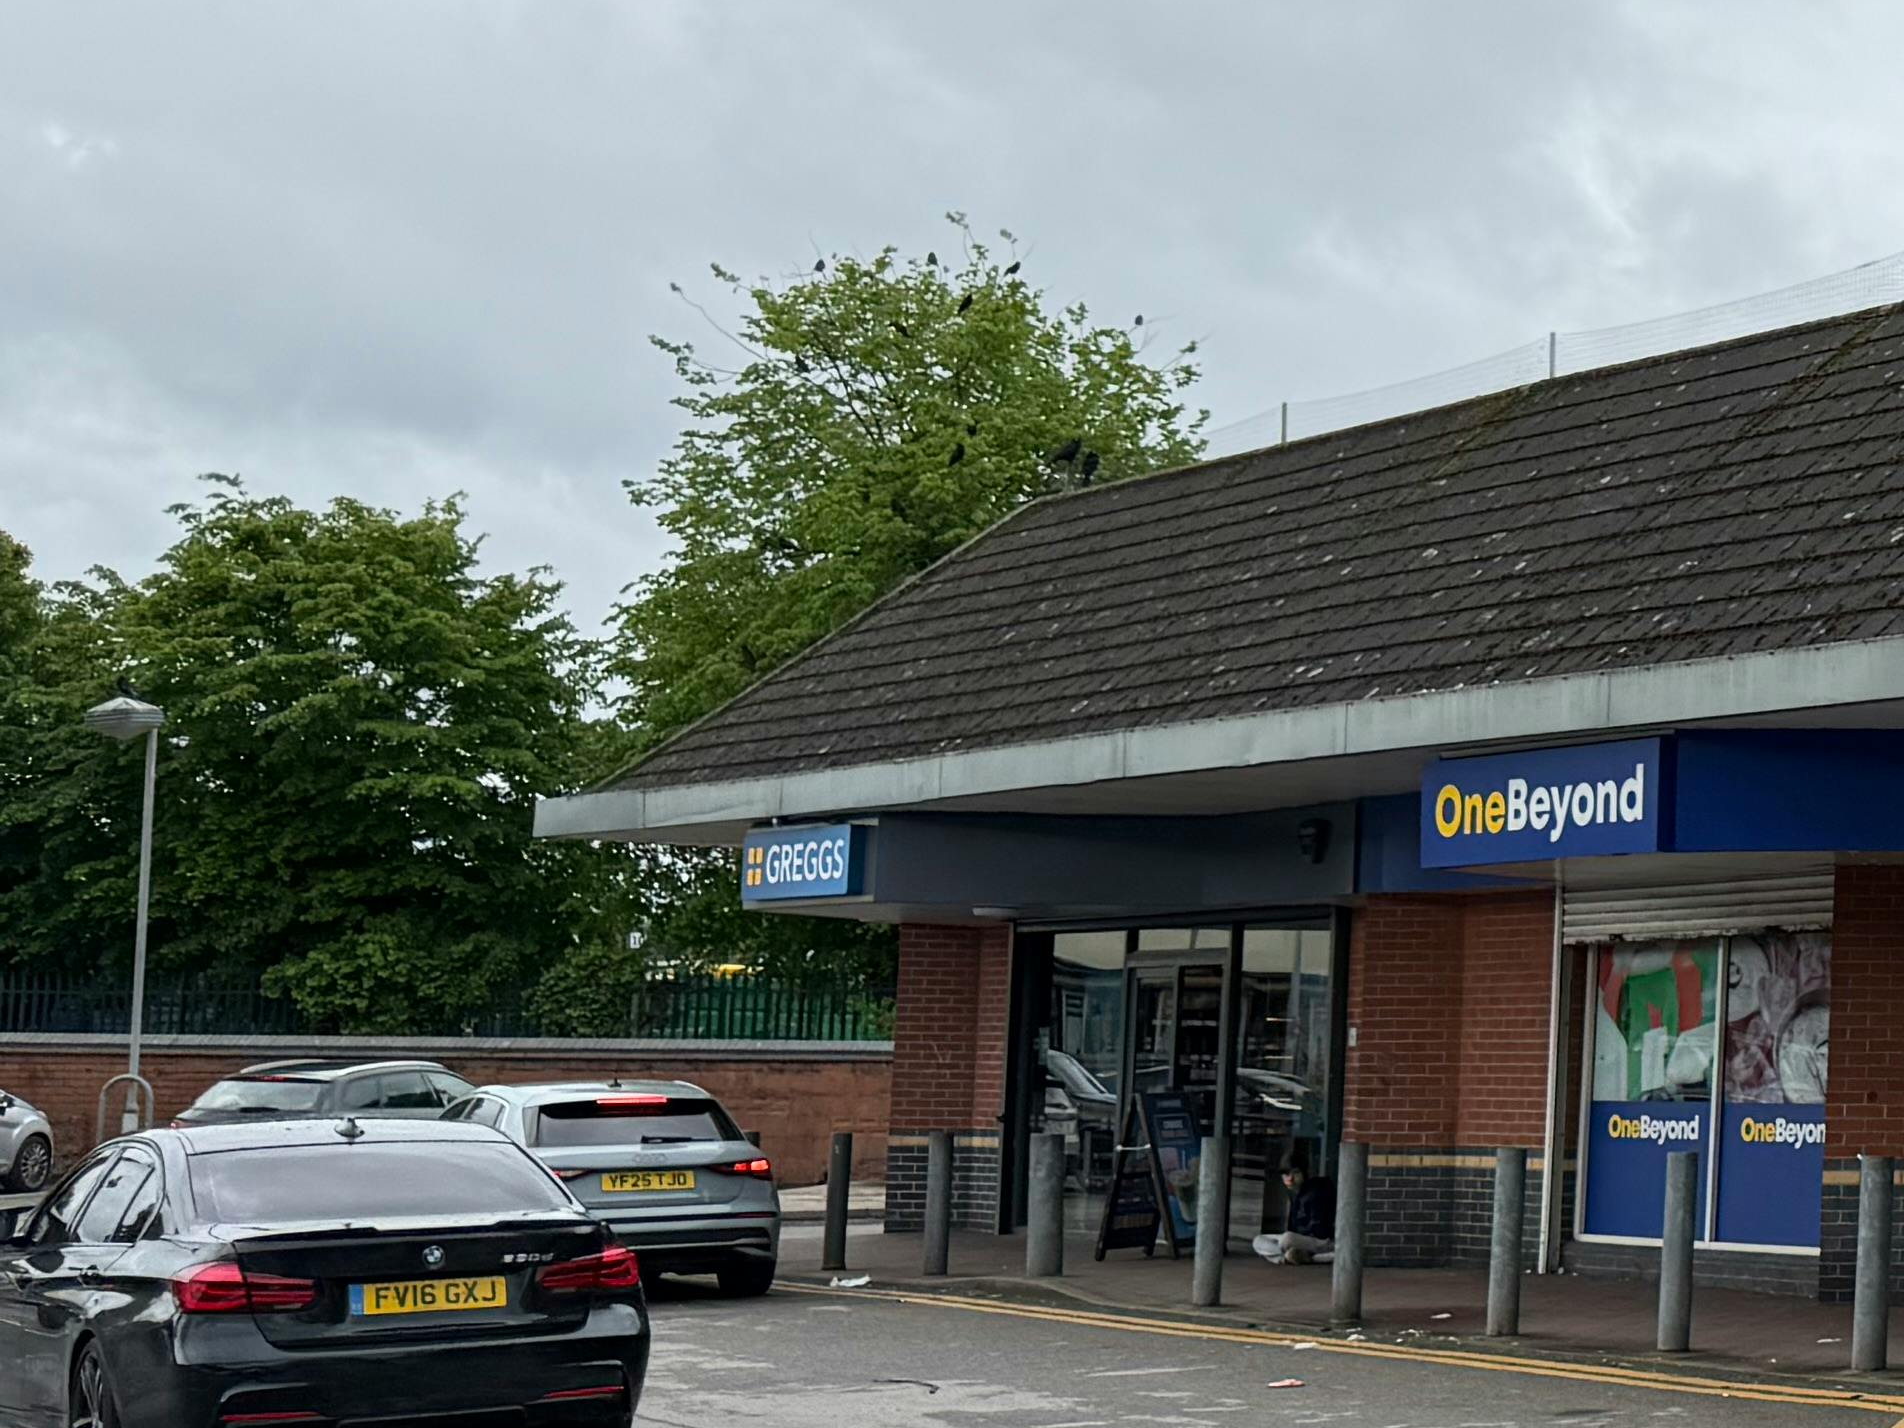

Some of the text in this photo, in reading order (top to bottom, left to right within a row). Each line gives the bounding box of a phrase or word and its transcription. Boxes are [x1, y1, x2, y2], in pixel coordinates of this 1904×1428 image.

[1434, 763, 1645, 843] OneBeyond
[766, 839, 844, 884] GREGGS
[1607, 1114, 1700, 1146] OneBeyond
[1740, 1117, 1826, 1150] OneBeyon
[609, 1174, 651, 1188] YF25
[374, 1280, 497, 1309] FV16 GXJ
